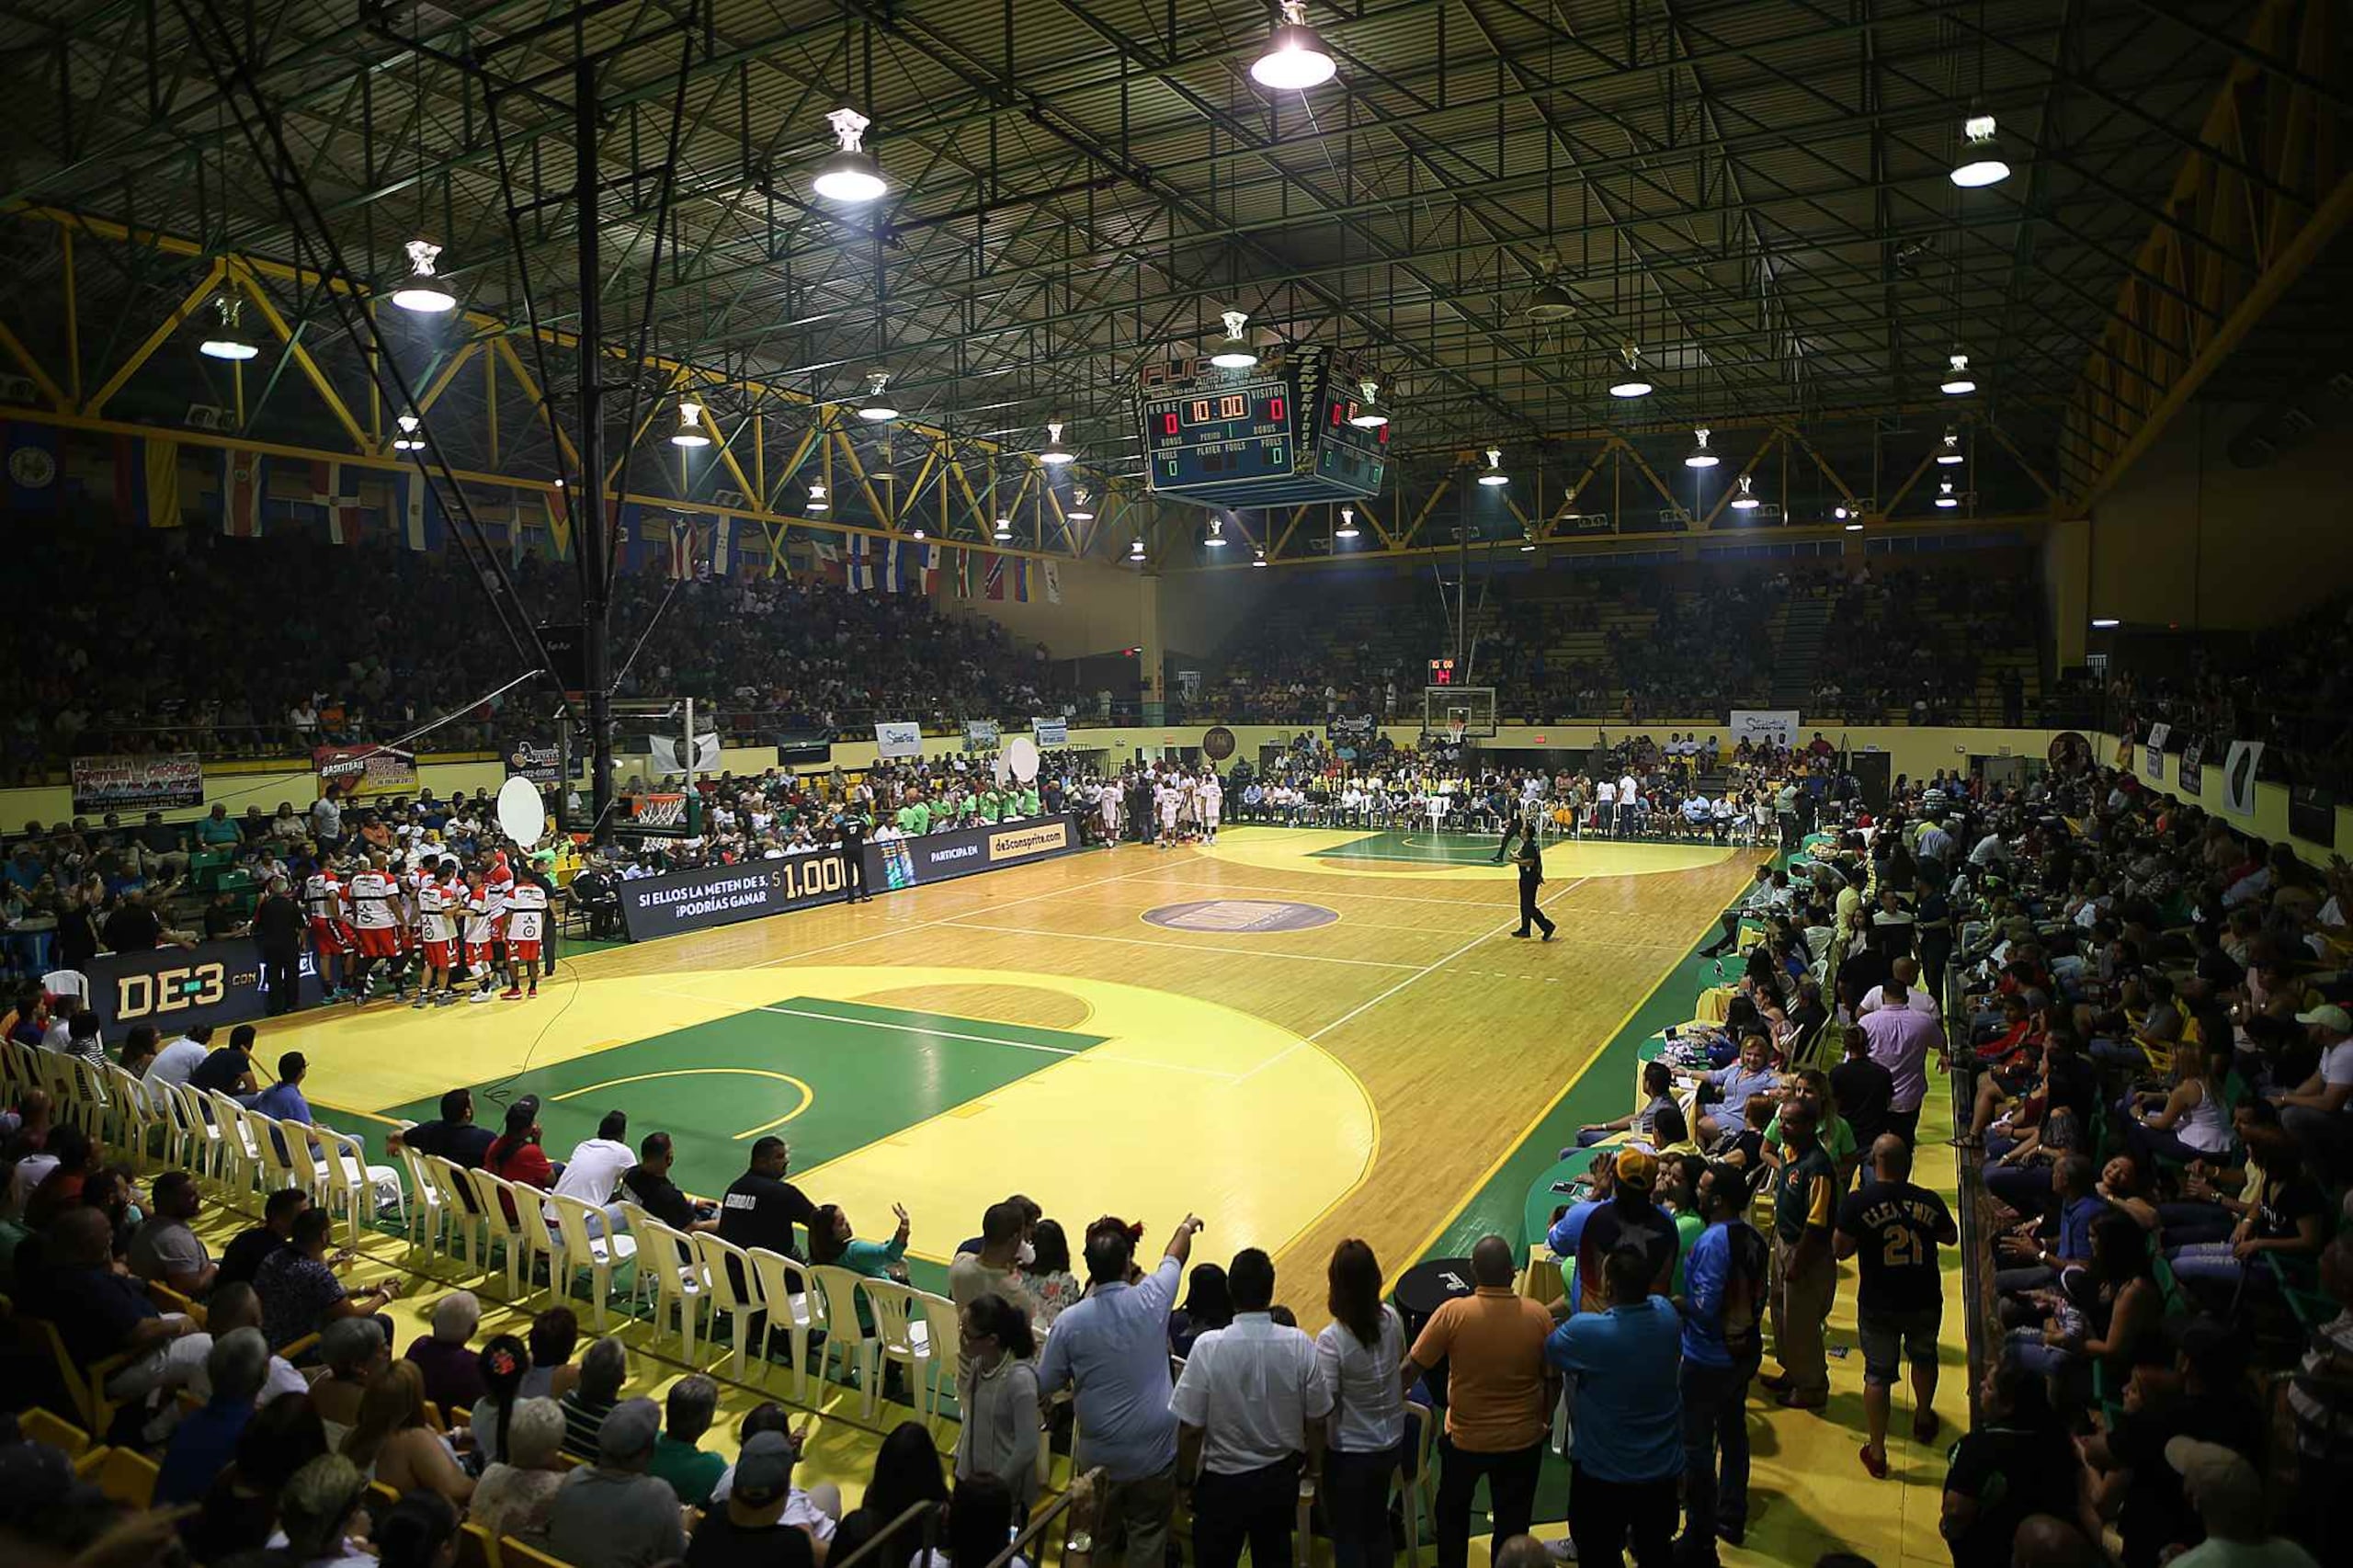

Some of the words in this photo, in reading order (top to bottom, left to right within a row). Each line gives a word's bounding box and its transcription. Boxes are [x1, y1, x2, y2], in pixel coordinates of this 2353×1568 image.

[1251, 386, 1285, 400] VISITOR
[1149, 403, 1177, 413] HOME
[1192, 396, 1245, 422] 10:00
[1197, 445, 1221, 456] PLAYER
[1225, 441, 1246, 452] FOULS
[930, 846, 966, 863] PARTICIPA
[966, 845, 978, 857] EN
[639, 893, 650, 907] SI
[653, 888, 688, 906] ELLOS
[688, 885, 703, 898] LA
[704, 879, 742, 896] METEN
[744, 876, 756, 890] DE
[730, 891, 767, 908] GANAR
[1881, 1223, 1924, 1267] 21
